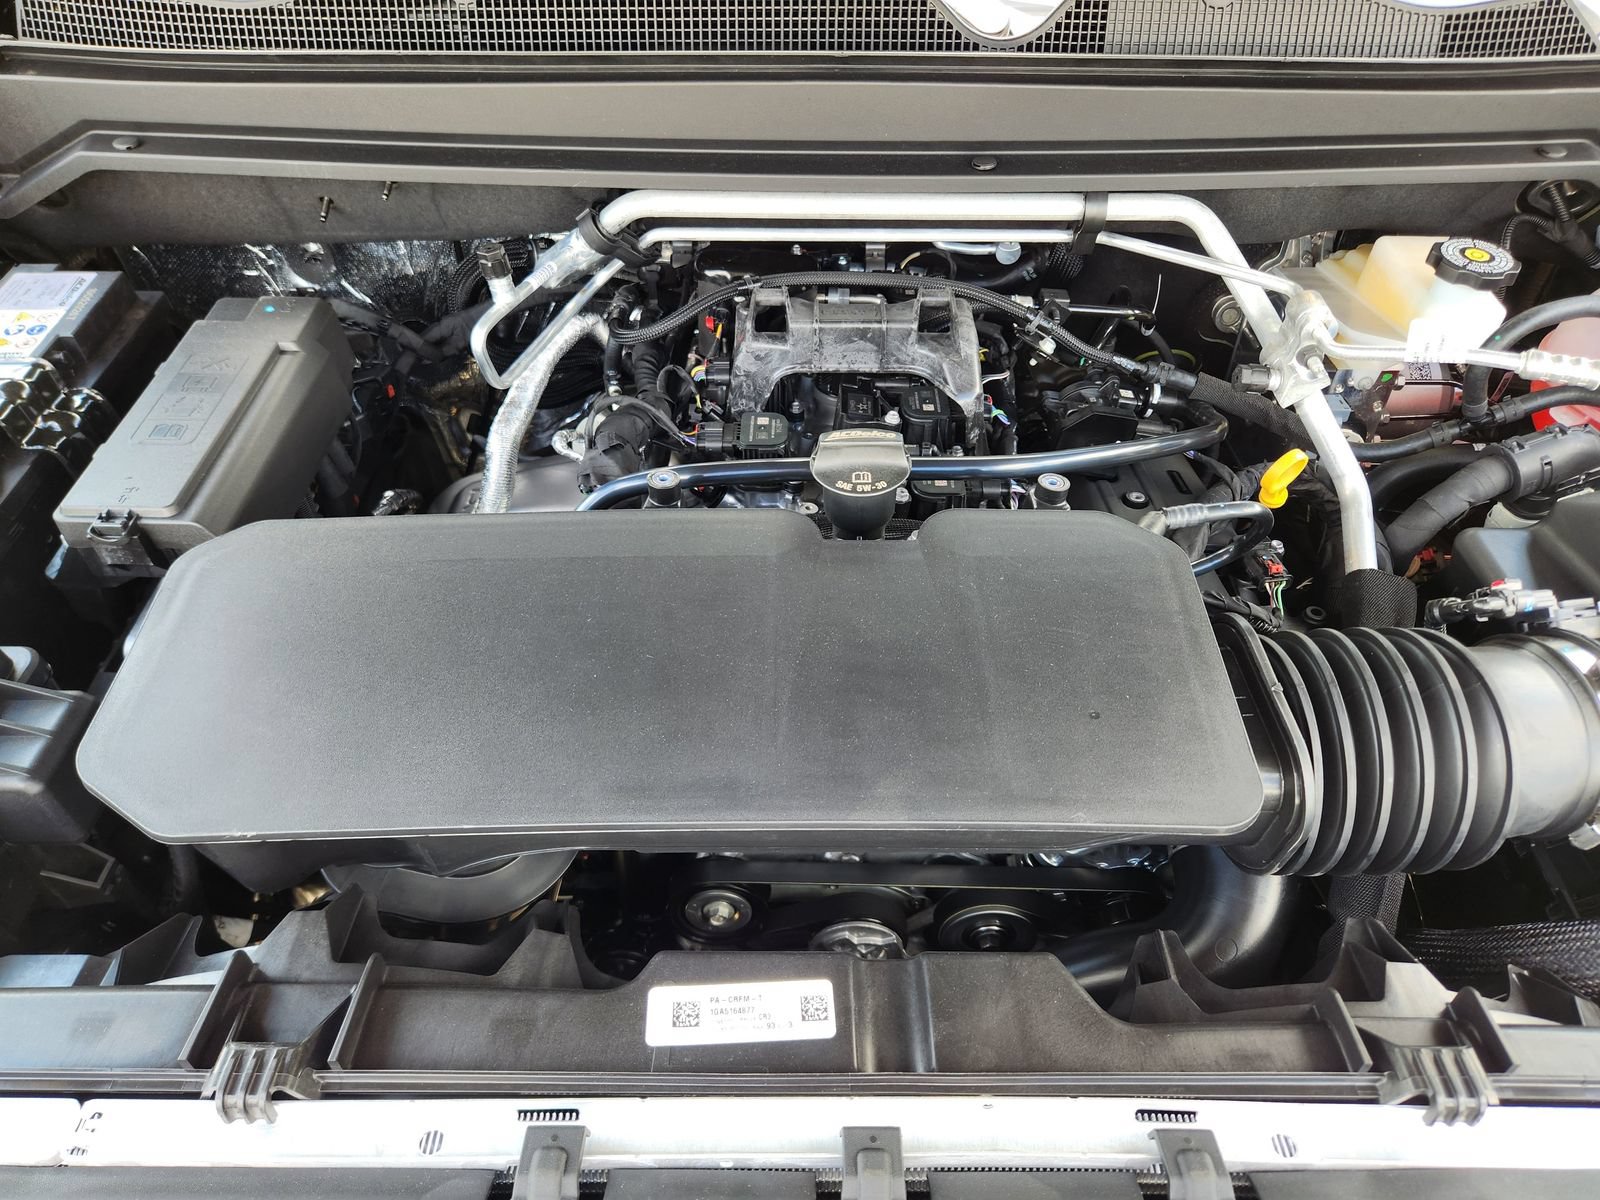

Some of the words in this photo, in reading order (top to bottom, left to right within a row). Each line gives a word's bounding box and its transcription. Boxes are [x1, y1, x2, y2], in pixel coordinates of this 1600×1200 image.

[826, 430, 897, 439] ACDelco
[835, 480, 853, 491] SAE
[856, 480, 888, 492] 5W-30
